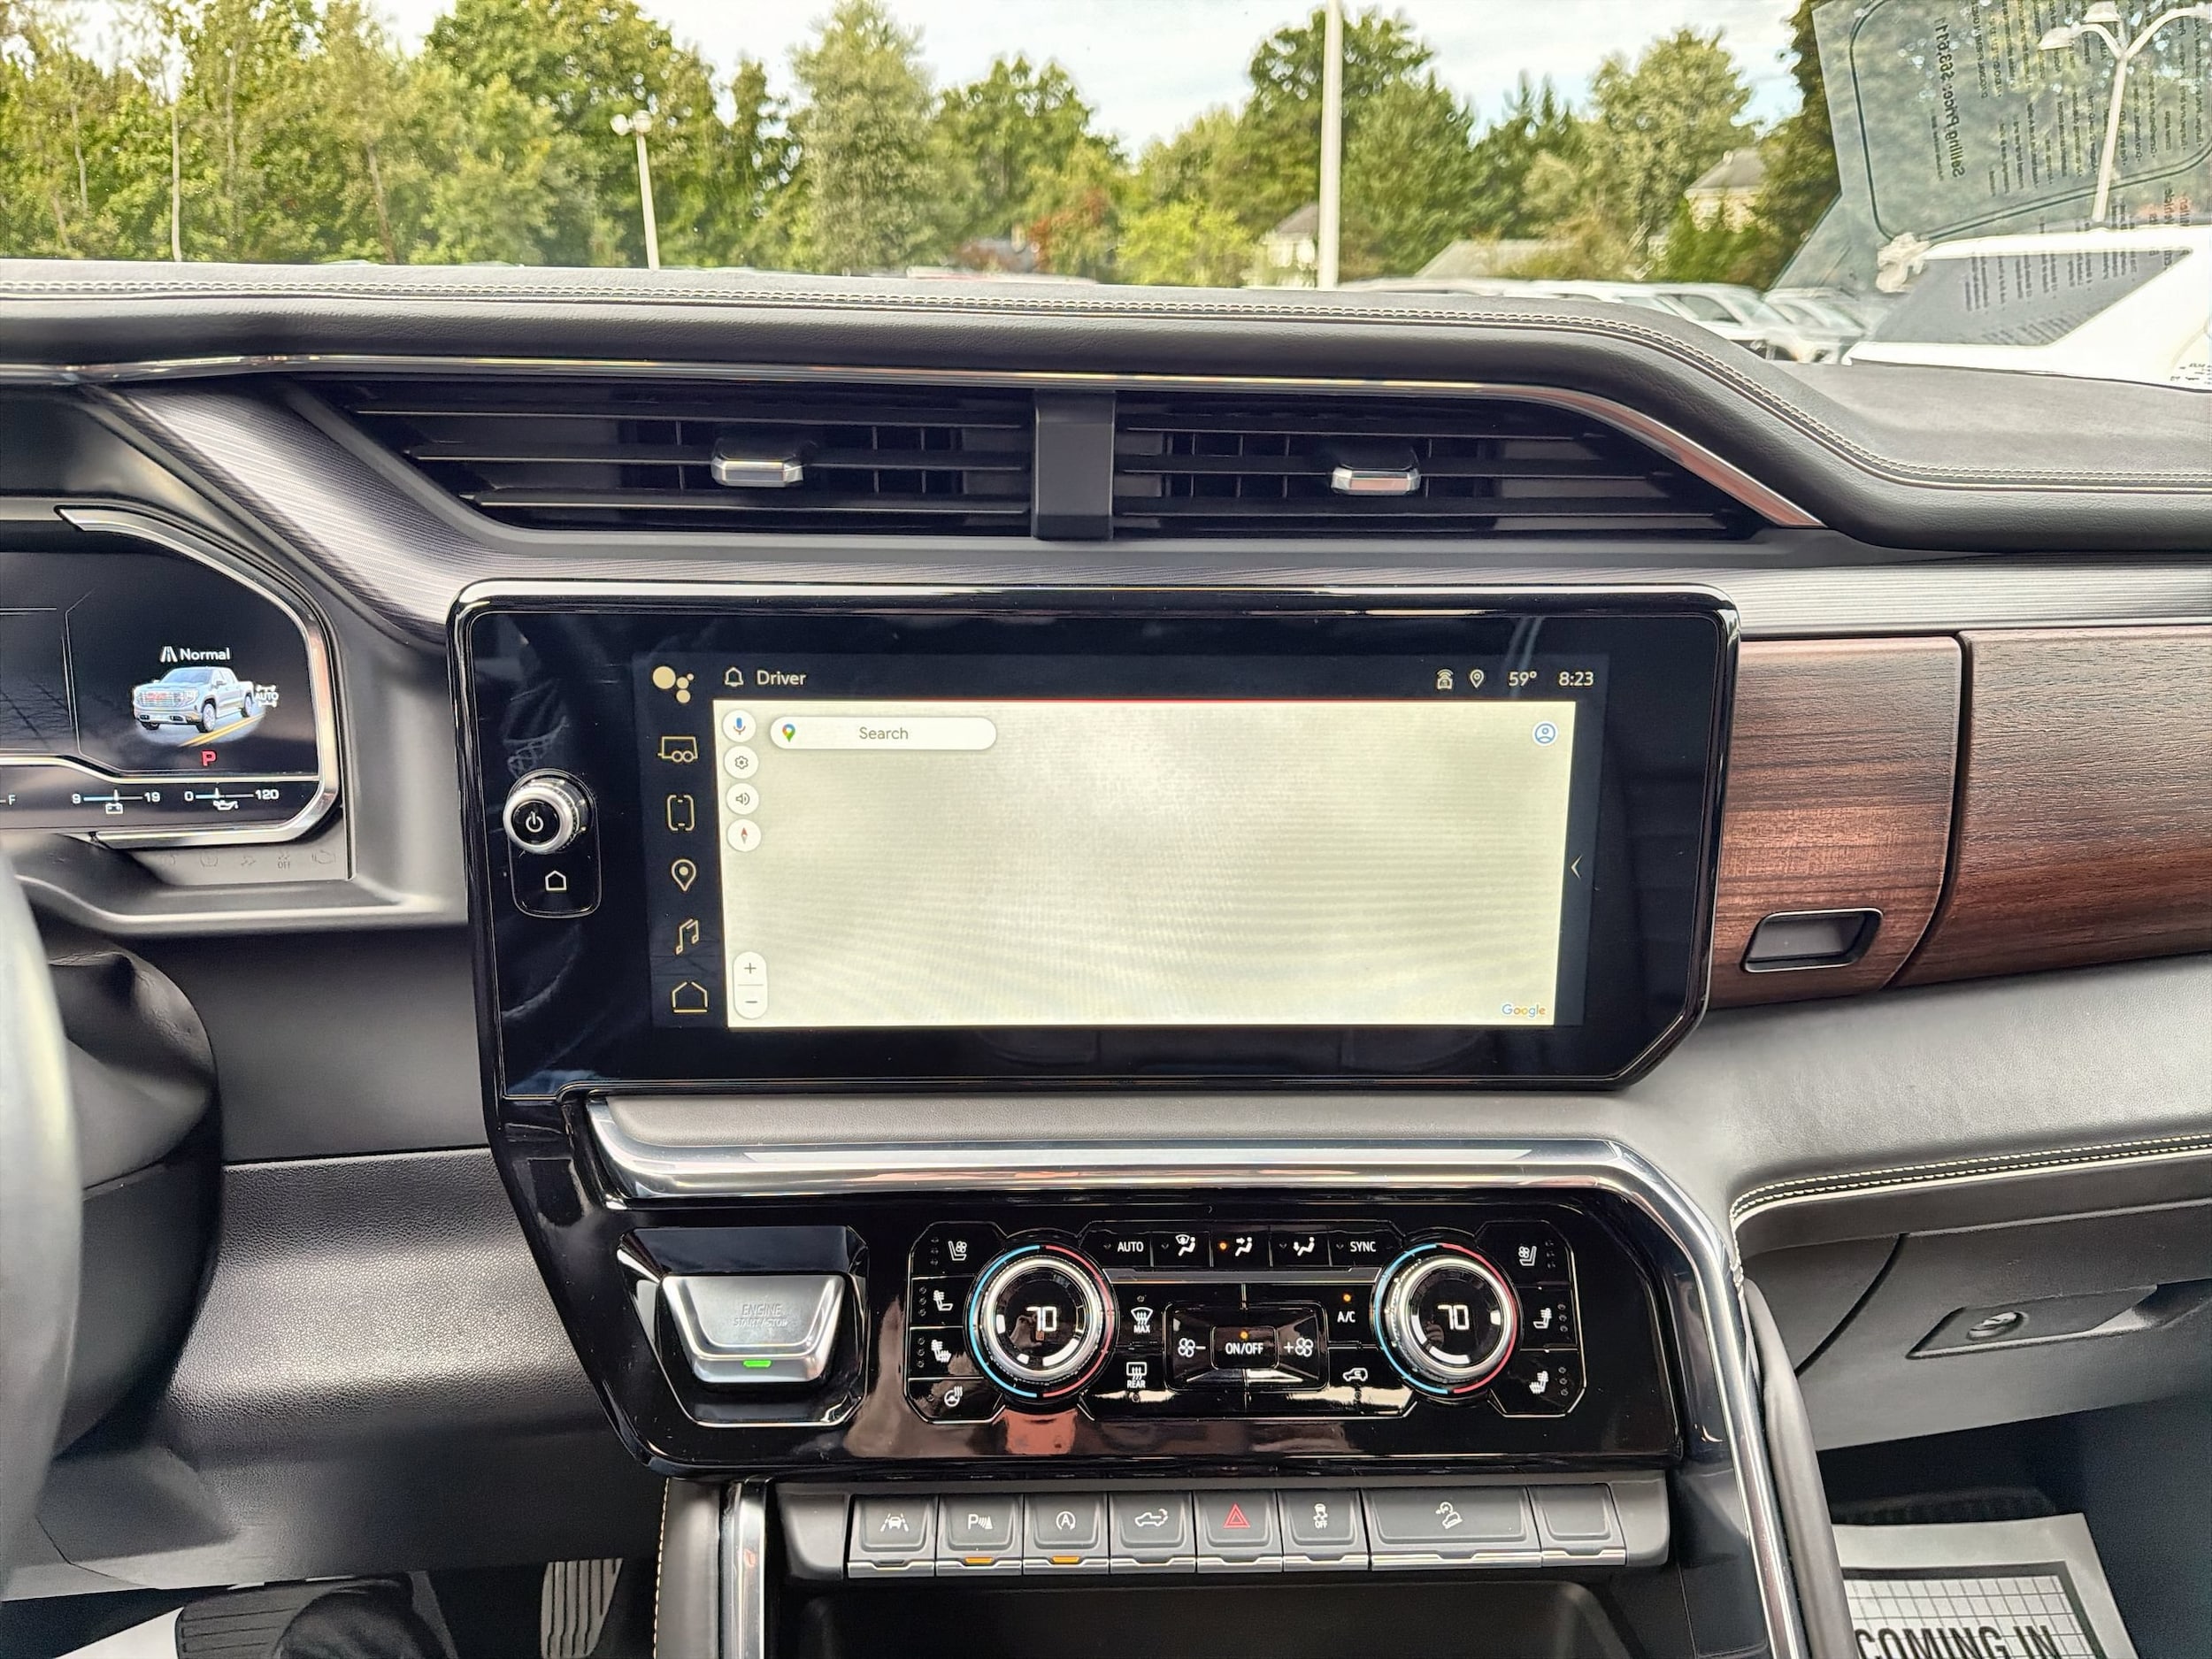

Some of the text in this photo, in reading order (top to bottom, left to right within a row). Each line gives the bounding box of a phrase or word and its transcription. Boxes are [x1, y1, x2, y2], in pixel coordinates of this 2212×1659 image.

[180, 647, 231, 661] Normal
[756, 669, 807, 686] Driver
[1508, 671, 1538, 687] 59°
[1558, 671, 1594, 687] 8:23
[254, 691, 280, 701] AUTO
[858, 726, 909, 741] Search
[202, 750, 216, 766] P
[8, 794, 16, 806] F
[72, 793, 81, 804] 9
[144, 791, 161, 803] 19
[184, 791, 194, 803] 0
[255, 788, 280, 801] 120
[1501, 1003, 1547, 1018] Google
[1117, 1241, 1144, 1253] AUTO
[1349, 1240, 1377, 1253] SYNC
[741, 1303, 783, 1317] ENGINE
[1337, 1310, 1356, 1324] A/C
[1025, 1305, 1057, 1333] 70
[1437, 1304, 1471, 1331] 70
[1133, 1325, 1151, 1334] MAX
[1225, 1342, 1264, 1356] ON/OFF
[1126, 1379, 1147, 1389] REAR
[1314, 1520, 1328, 1529] OFF
[1854, 1624, 2062, 1659] COMING IN
